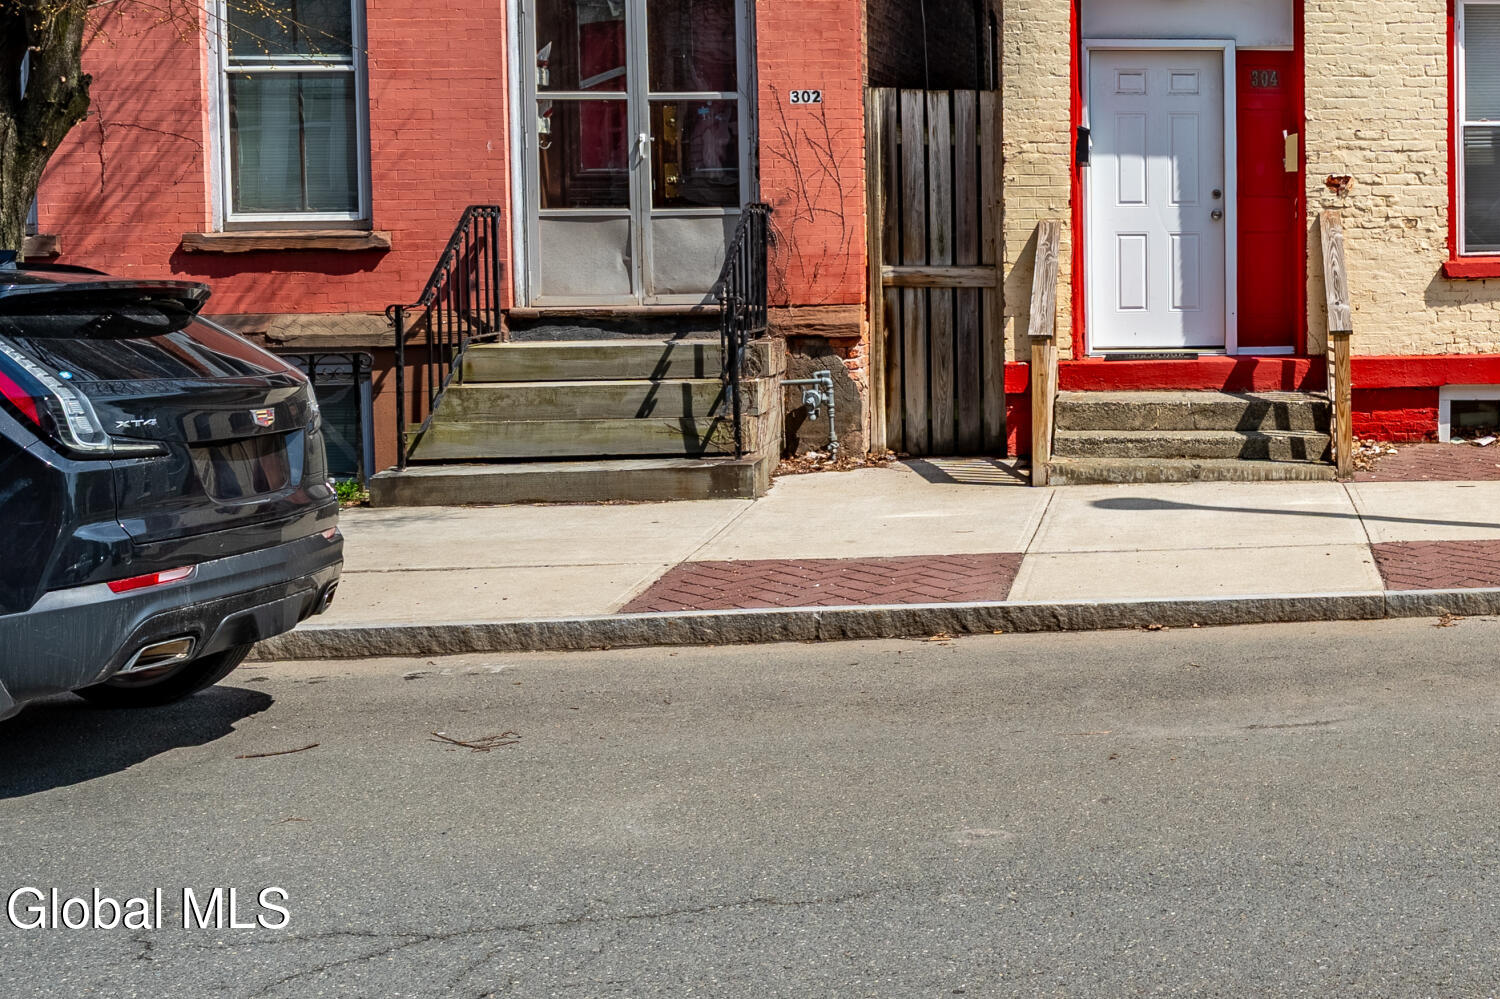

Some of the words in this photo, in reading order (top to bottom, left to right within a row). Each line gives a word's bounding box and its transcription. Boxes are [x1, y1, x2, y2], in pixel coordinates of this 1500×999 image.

[1251, 70, 1278, 87] 304
[791, 90, 821, 103] 302
[115, 418, 158, 429] XT4
